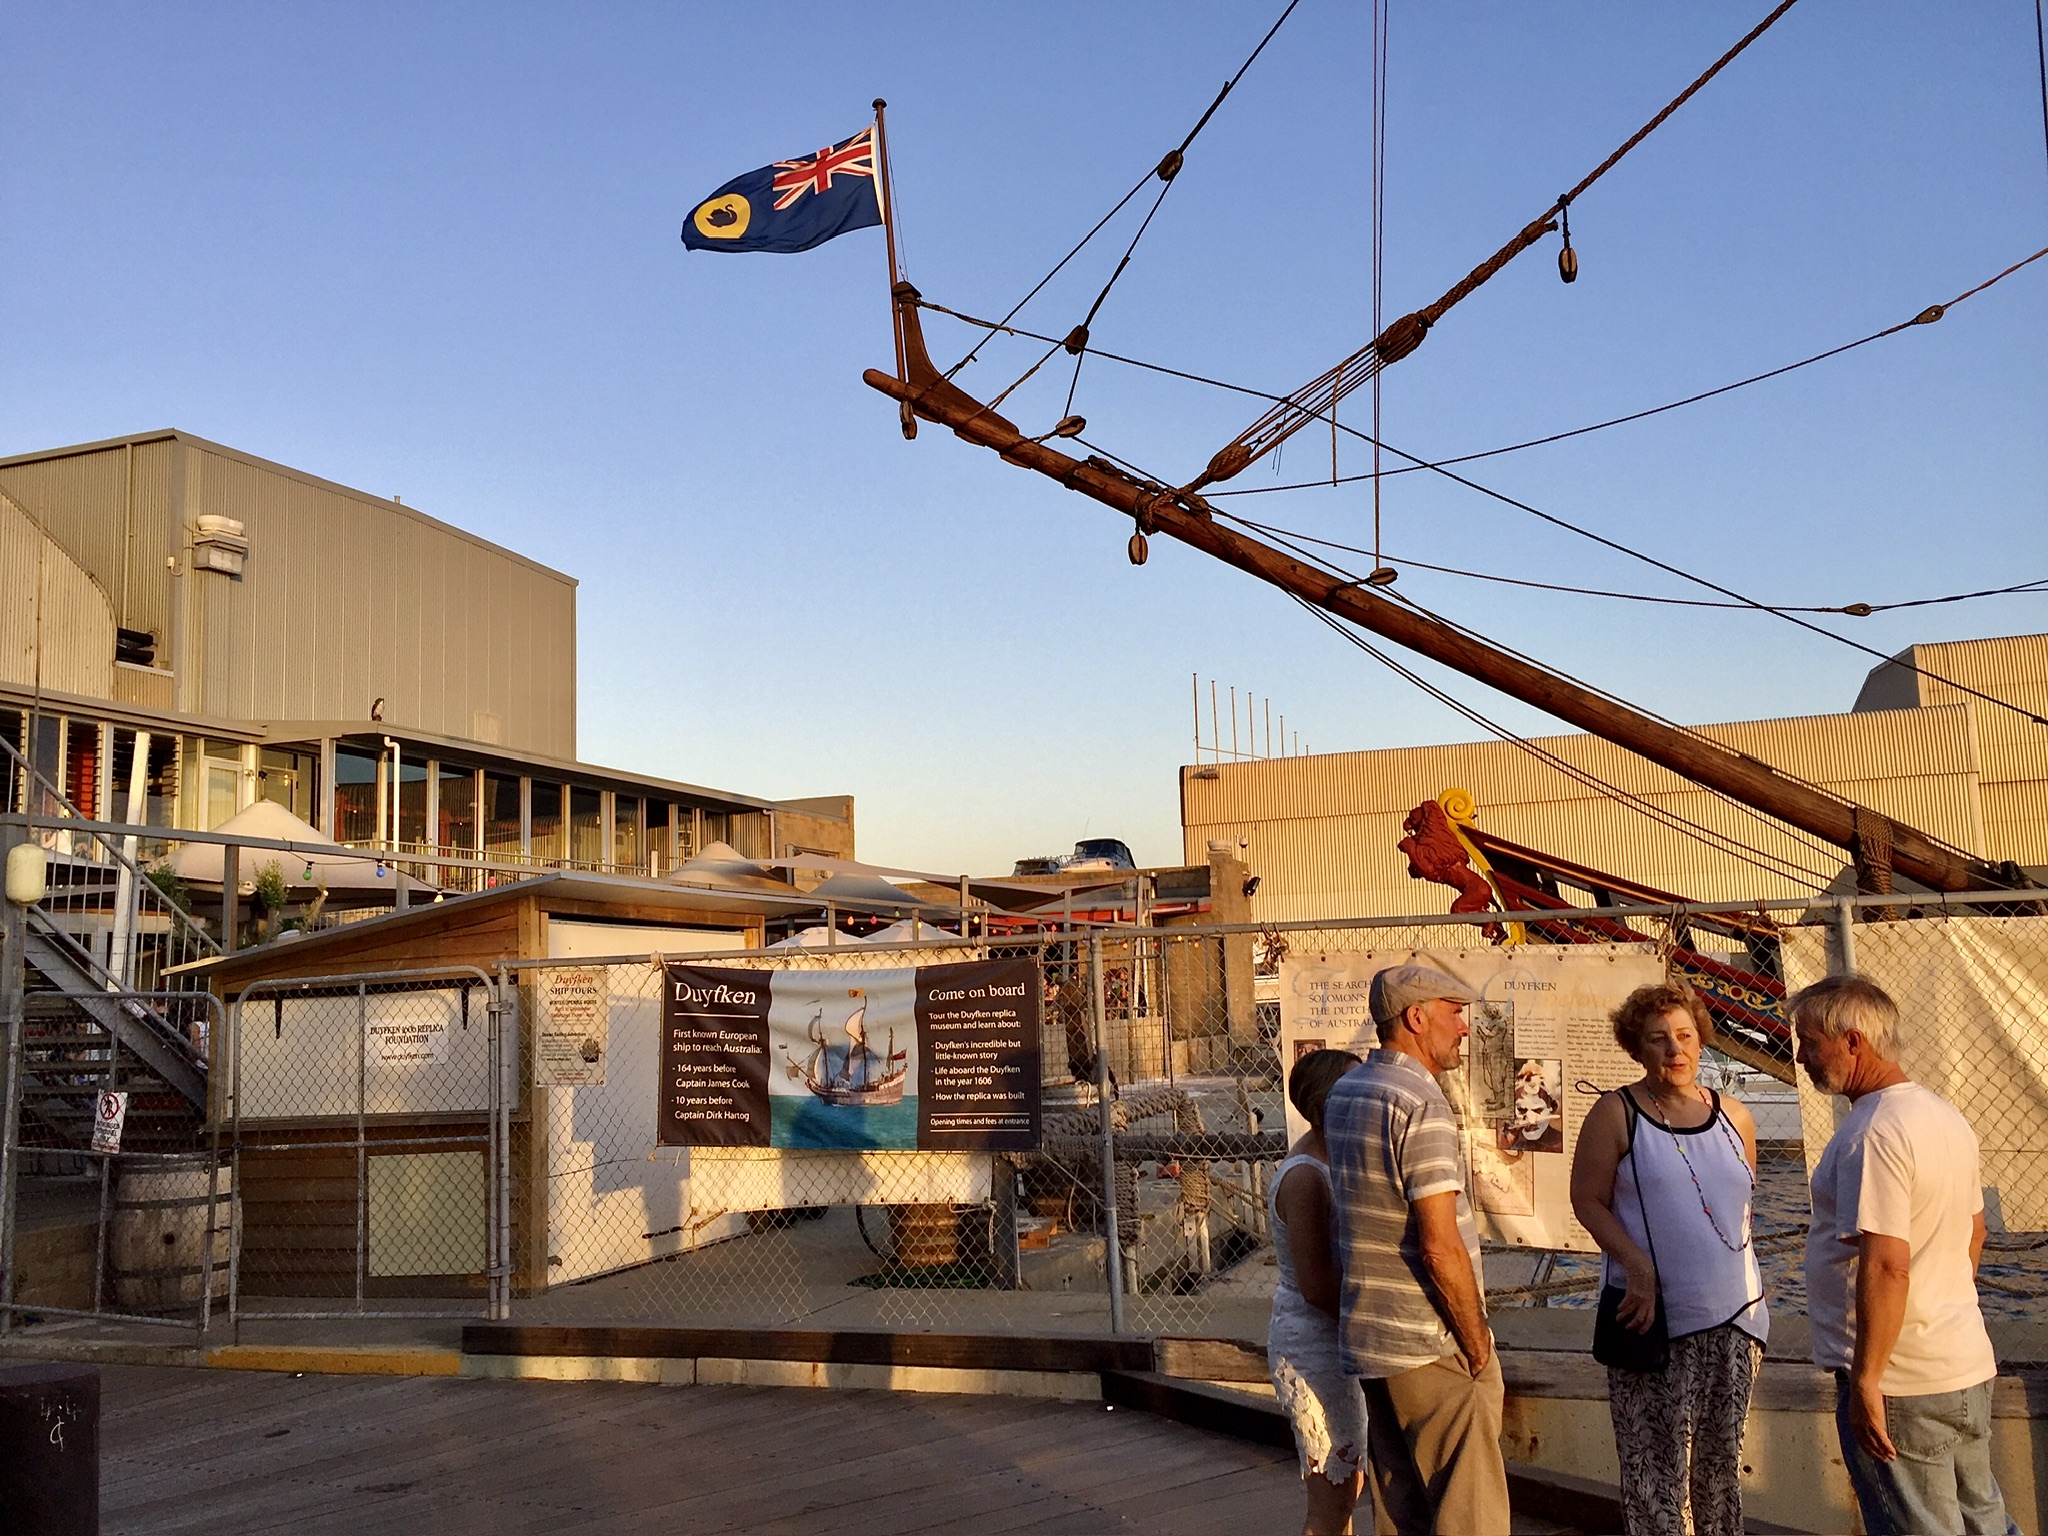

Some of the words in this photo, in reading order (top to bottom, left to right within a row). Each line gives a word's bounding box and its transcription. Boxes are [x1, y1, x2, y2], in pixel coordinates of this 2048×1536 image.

[555, 974, 594, 986] Duyfken
[1309, 981, 1329, 990] THE
[1332, 980, 1372, 990] SEARCH
[550, 987, 569, 995] SHIP
[570, 987, 597, 995] TOURS
[928, 989, 965, 1001] Come
[968, 988, 986, 998] on
[988, 982, 1025, 997] board
[1504, 981, 1557, 991] DUYFKEN
[674, 981, 756, 1008] Duyfken
[1308, 993, 1367, 1003] SOLOMON'S
[928, 1012, 945, 1020] Tour
[947, 1011, 960, 1019] the
[960, 1010, 991, 1020] Duyfken
[991, 1009, 1016, 1019] replica
[1310, 1007, 1329, 1016] THE
[1333, 1005, 1370, 1015] DUTCH
[370, 1026, 400, 1035] DUYFKEN
[417, 1024, 444, 1033] REPLICA
[963, 1021, 977, 1029] and
[997, 1020, 1021, 1028] about:
[1309, 1020, 1323, 1028] OF
[385, 1034, 429, 1045] FOUNDATION
[673, 1029, 691, 1038] First
[692, 1029, 717, 1039] known
[719, 1030, 758, 1042] European
[673, 1042, 691, 1053] ship
[692, 1044, 701, 1052] to
[702, 1043, 722, 1052] reach
[723, 1043, 763, 1054] Australia:
[935, 1041, 969, 1050] Duyfken's
[970, 1039, 1007, 1049] incredible
[1008, 1039, 1021, 1047] but
[935, 1051, 978, 1060] little-known
[979, 1052, 998, 1060] story
[677, 1064, 691, 1073] 164
[692, 1065, 712, 1074] years
[713, 1064, 736, 1073] before
[935, 1066, 948, 1075] Life
[949, 1066, 975, 1074] aboard
[976, 1066, 988, 1074] the
[990, 1065, 1020, 1075] Duyfken
[675, 1078, 706, 1089] Captain
[707, 1079, 730, 1088] James
[731, 1079, 750, 1088] Cook
[935, 1078, 942, 1086] in
[943, 1077, 956, 1085] the
[957, 1079, 973, 1087] year
[974, 1076, 993, 1085] 1606
[676, 1096, 685, 1104] 10
[686, 1097, 707, 1106] years
[708, 1096, 733, 1104] before
[935, 1092, 953, 1100] How
[953, 1092, 965, 1100] the
[966, 1092, 991, 1101] replica
[1008, 1091, 1025, 1099] built
[674, 1110, 704, 1121] Captain
[706, 1110, 723, 1119] Dirk
[724, 1111, 750, 1122] Hartog
[930, 1118, 956, 1126] Opening
[956, 1117, 972, 1125] times
[973, 1117, 985, 1125] and
[985, 1117, 997, 1125] fees
